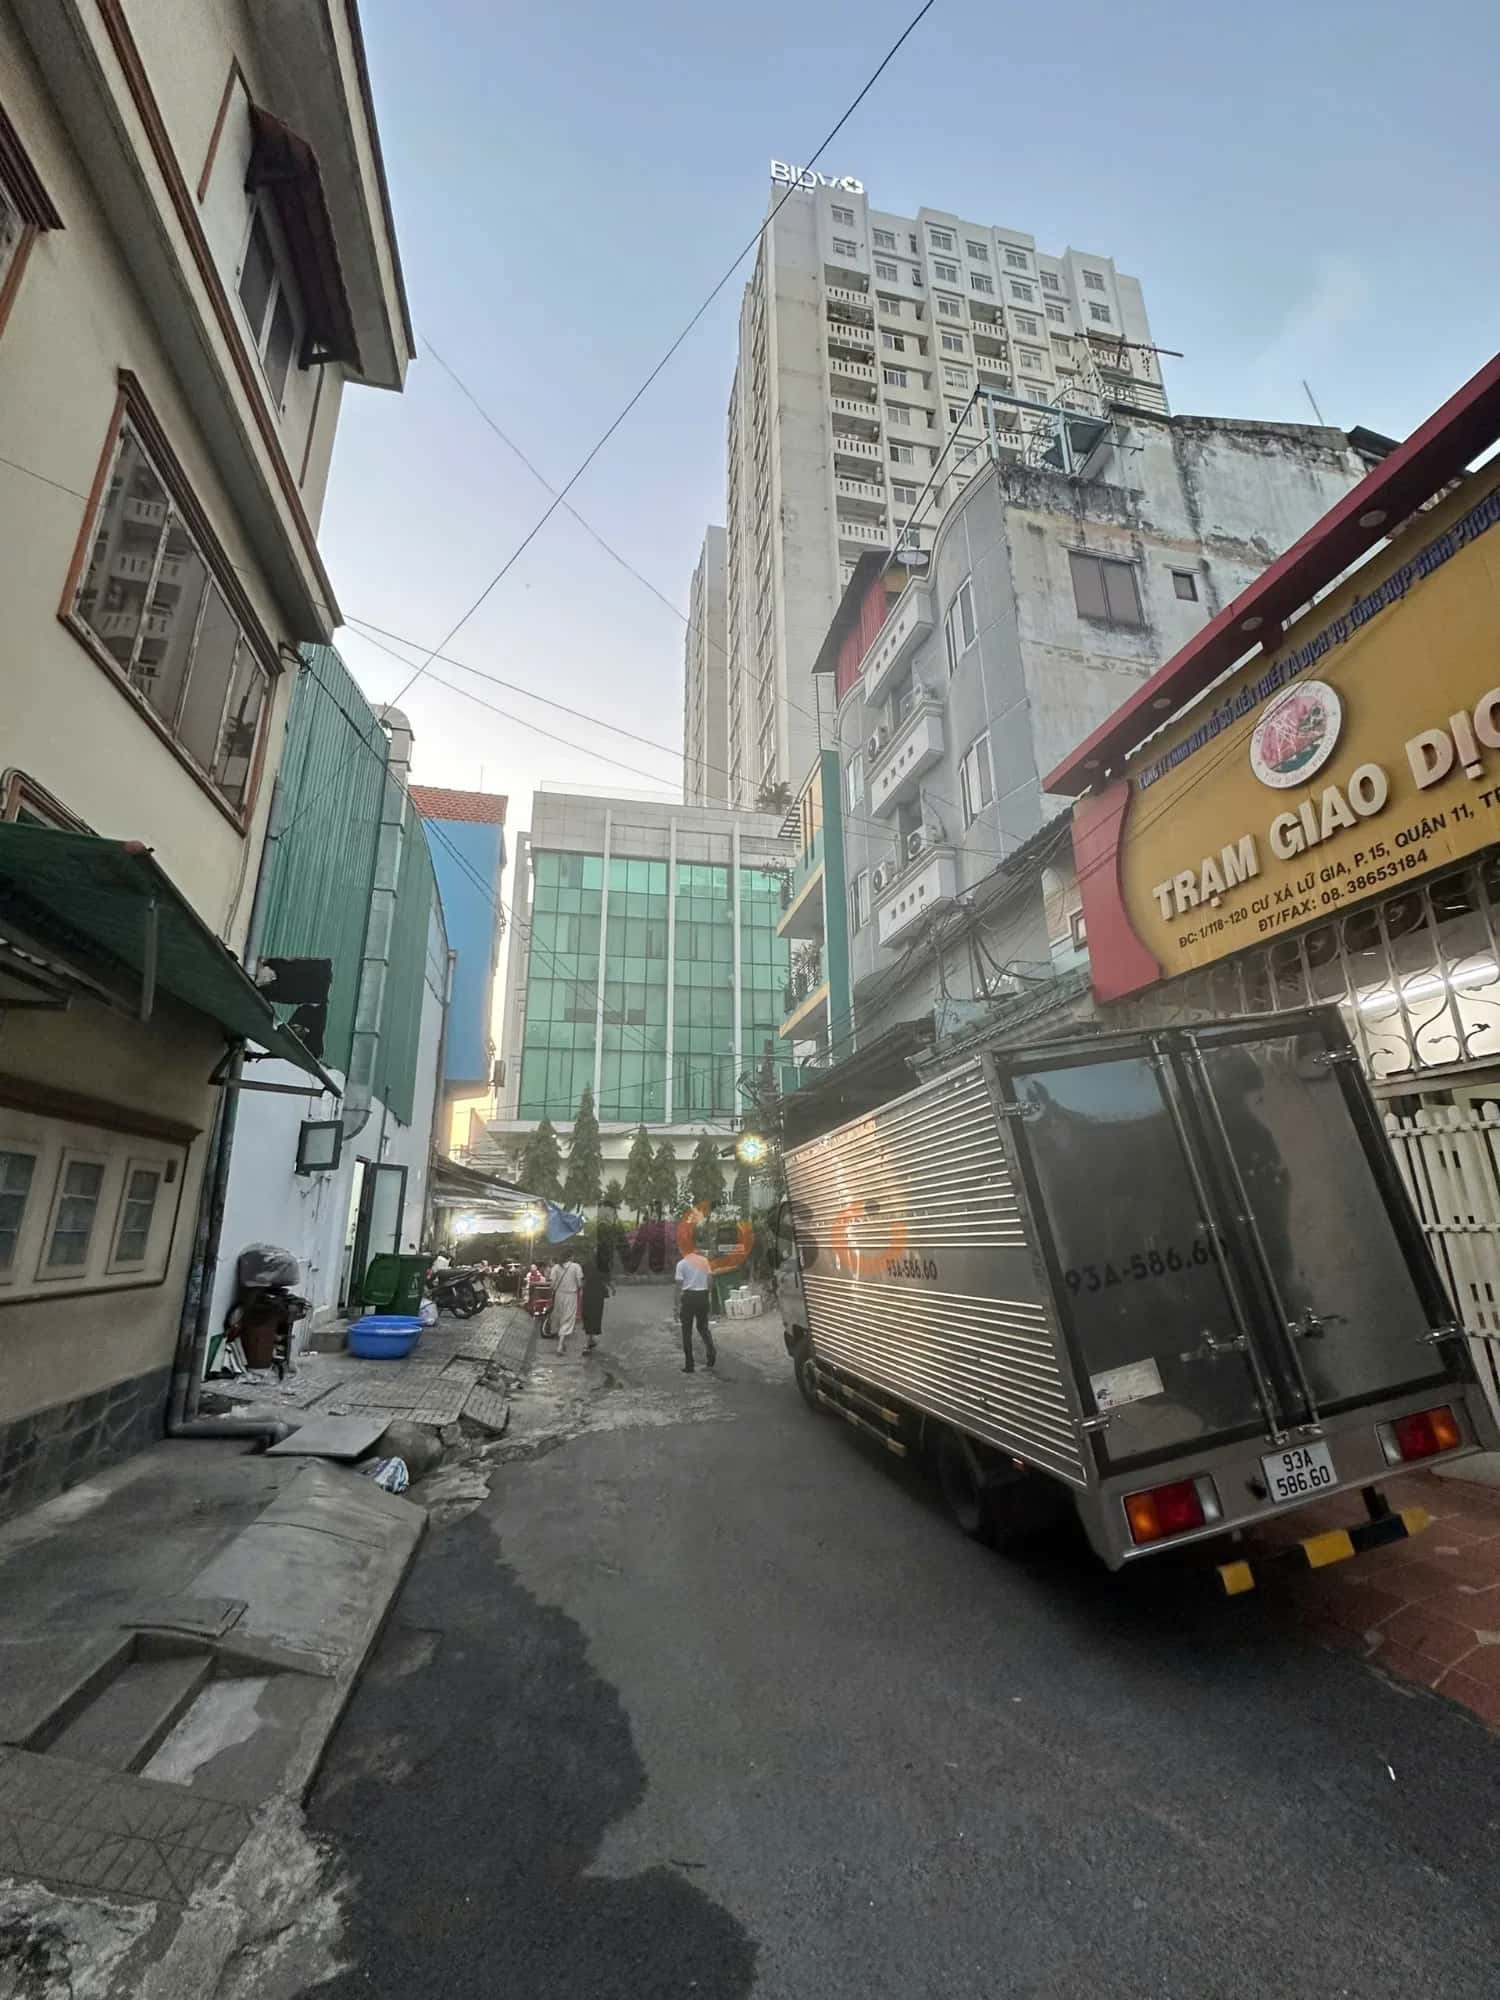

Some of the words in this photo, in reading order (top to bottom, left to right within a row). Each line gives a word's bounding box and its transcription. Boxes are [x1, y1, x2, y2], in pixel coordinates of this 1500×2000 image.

[1152, 833, 1260, 921] TRẠM
[1270, 763, 1389, 860] GIAO
[1179, 932, 1198, 948] ĐC:
[1251, 893, 1270, 914] CƯ
[1297, 871, 1316, 895] LỮ
[1320, 861, 1352, 883] GIA,
[1394, 813, 1447, 848] QUẬN
[1451, 803, 1475, 823] 11,
[1258, 898, 1318, 932] ĐT/FAX:
[1282, 1448, 1314, 1472] 93A
[1276, 1465, 1331, 1497] 586.60
